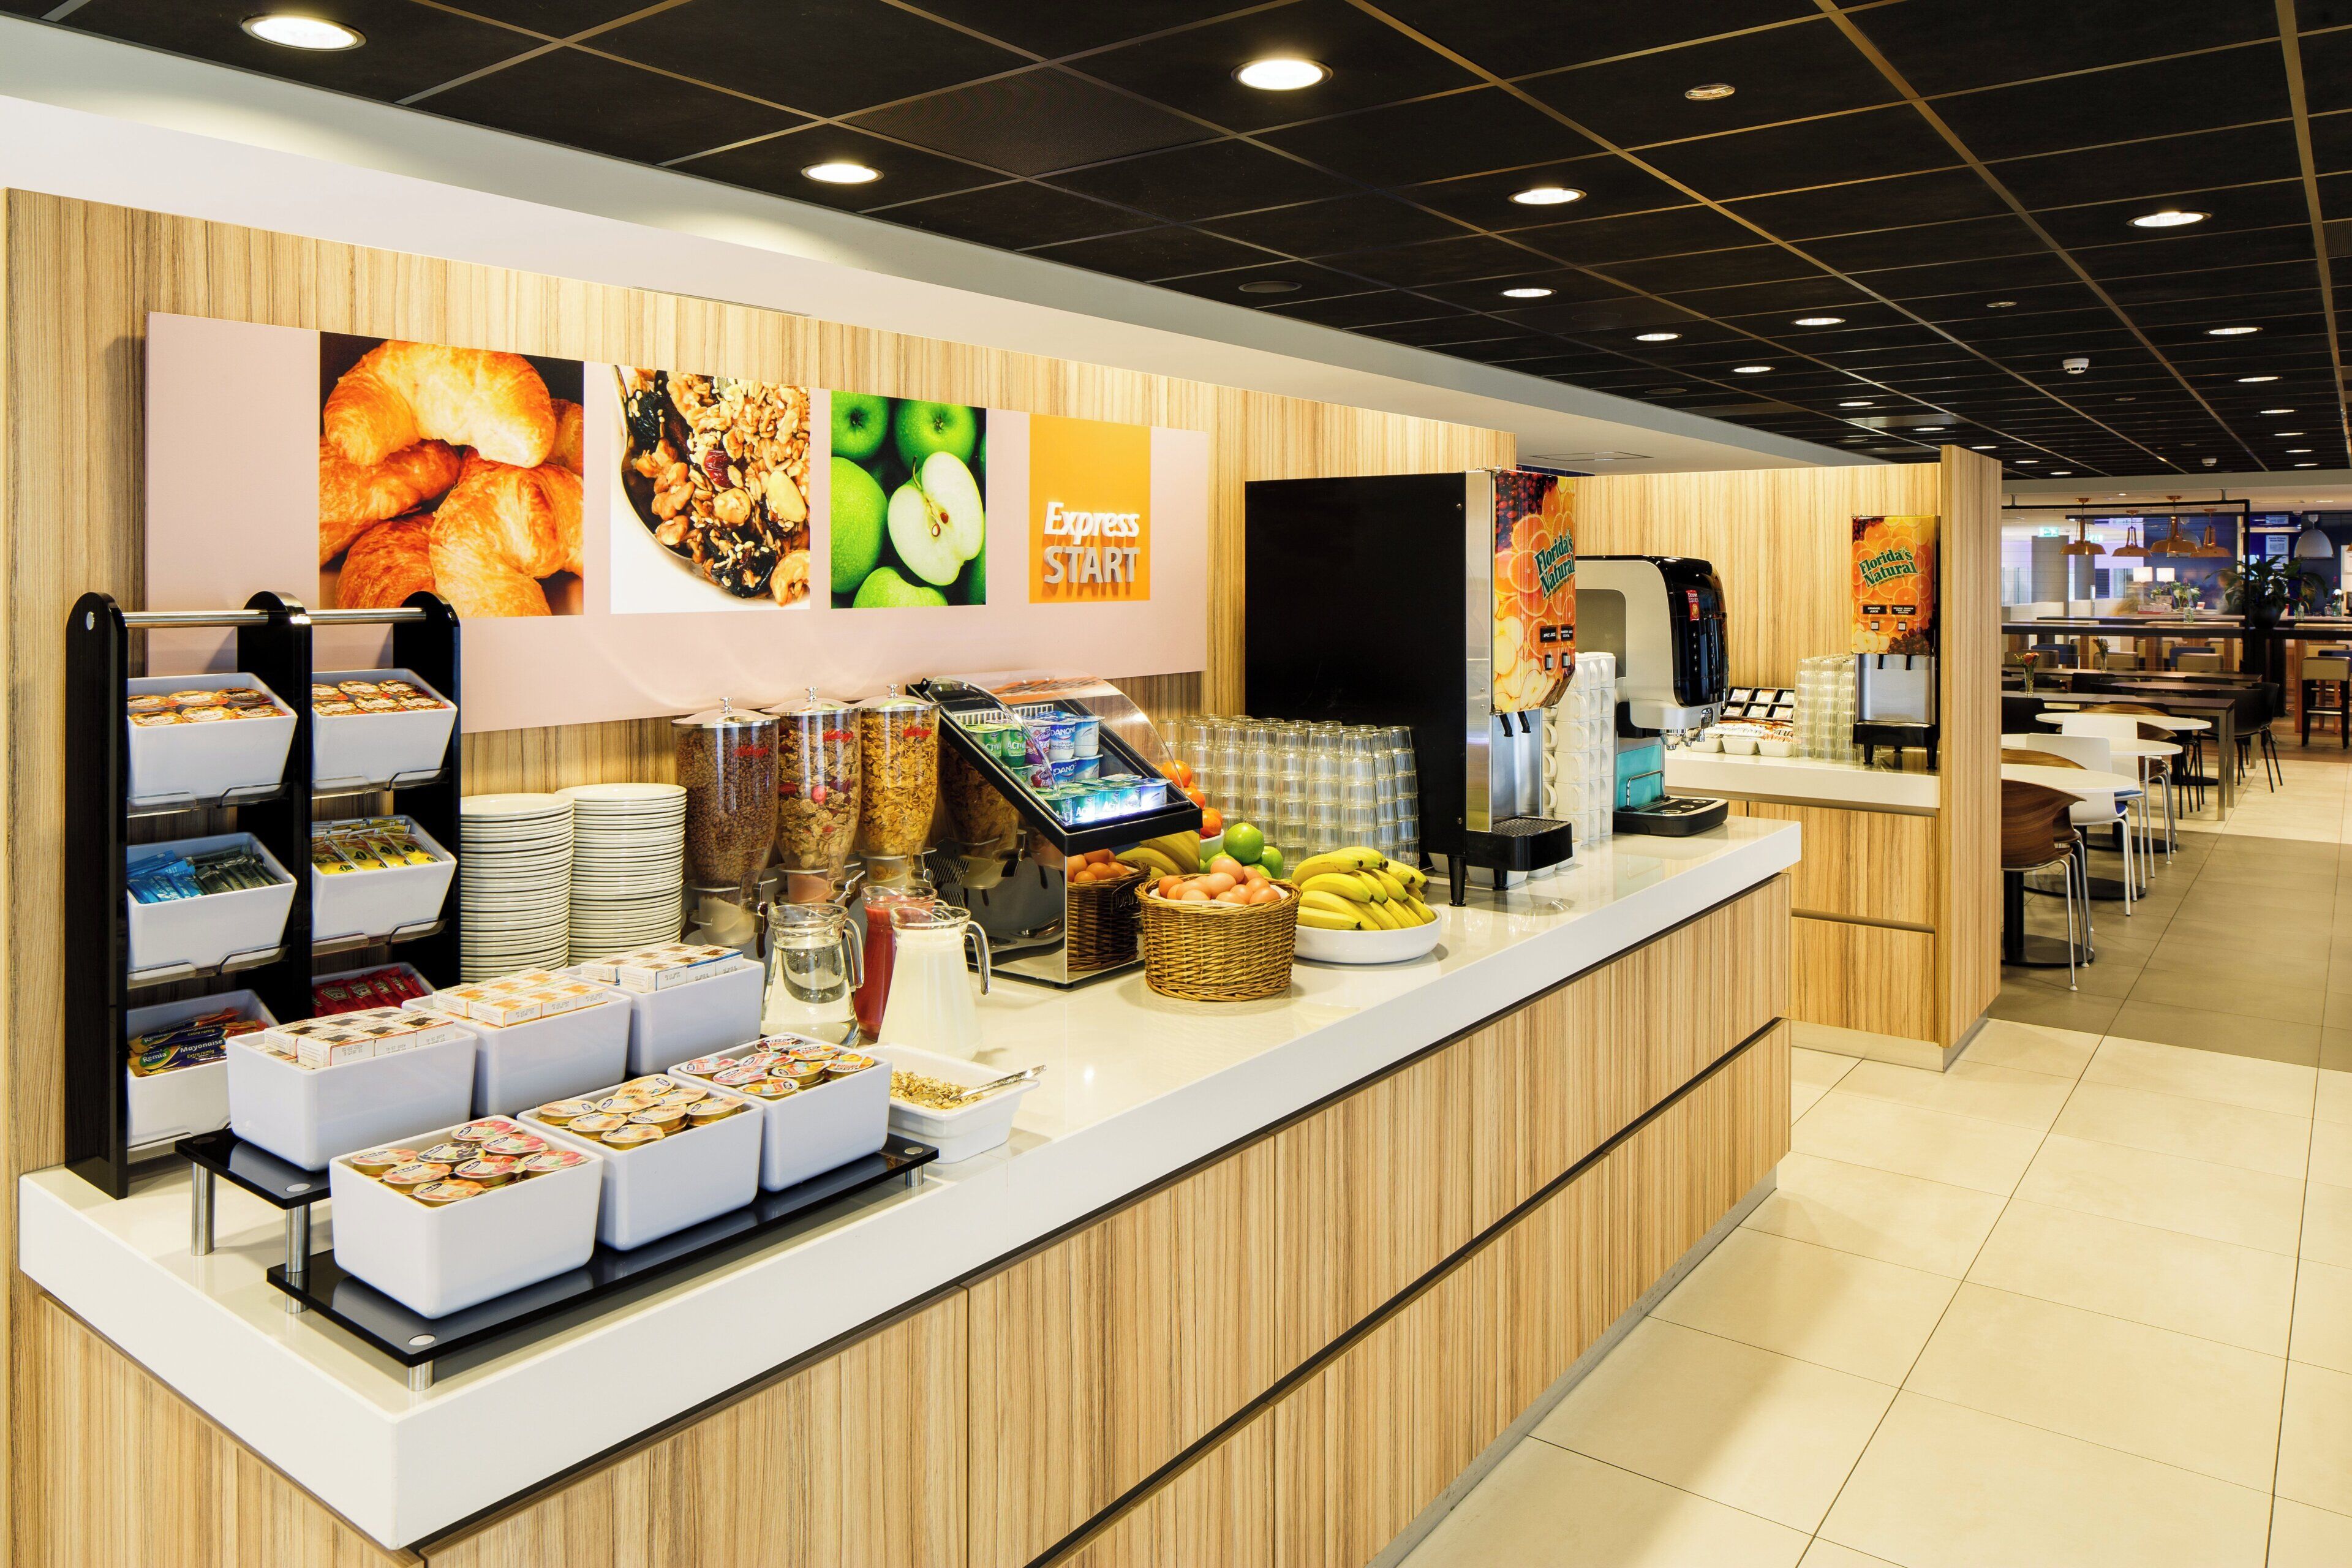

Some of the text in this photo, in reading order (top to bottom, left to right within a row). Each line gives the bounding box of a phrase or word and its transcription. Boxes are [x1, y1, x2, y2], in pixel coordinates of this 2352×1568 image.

[1044, 501, 1140, 545] Express
[1043, 545, 1140, 584] START
[1534, 533, 1574, 576] Florida's
[1859, 547, 1913, 575] Florida's
[1540, 553, 1575, 598] Natural
[1863, 561, 1918, 587] Natural
[1050, 726, 1076, 736] DANONE
[142, 1052, 167, 1063] Remia
[180, 1038, 223, 1053] Mayonaise
